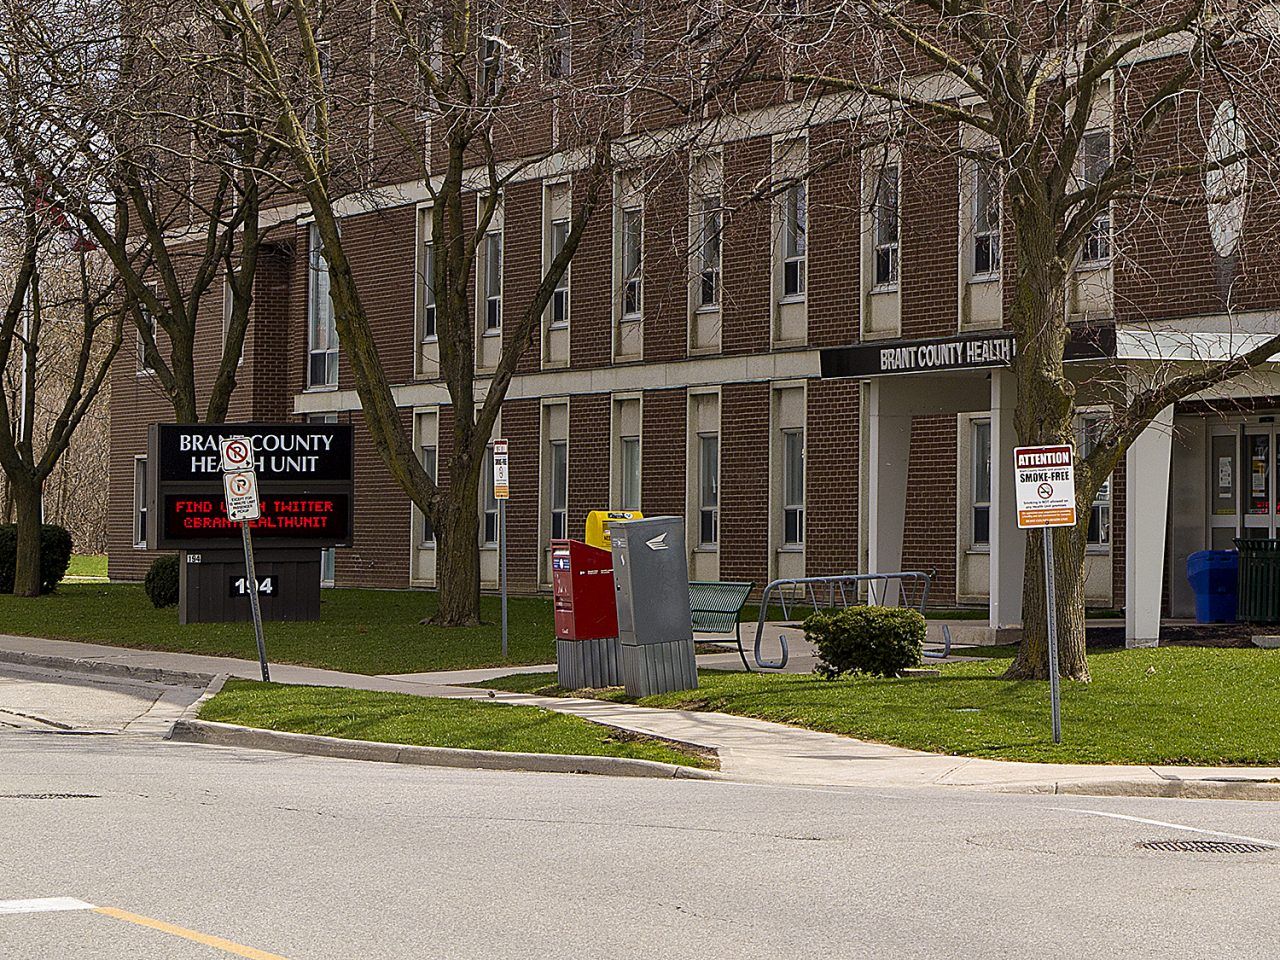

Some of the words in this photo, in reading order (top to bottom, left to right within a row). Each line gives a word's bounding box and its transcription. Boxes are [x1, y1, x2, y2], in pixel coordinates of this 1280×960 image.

[880, 346, 918, 371] BRANT
[917, 342, 964, 368] COUNTY
[966, 338, 1011, 363] HEALTH
[180, 434, 245, 451] BRA
[251, 434, 334, 452] COUNTY
[270, 456, 319, 473] UNIT
[1018, 451, 1070, 466] ATTENTION
[1019, 471, 1070, 483] SMOKE-FREE
[175, 501, 213, 513] FIND
[273, 501, 334, 513] TWITTER
